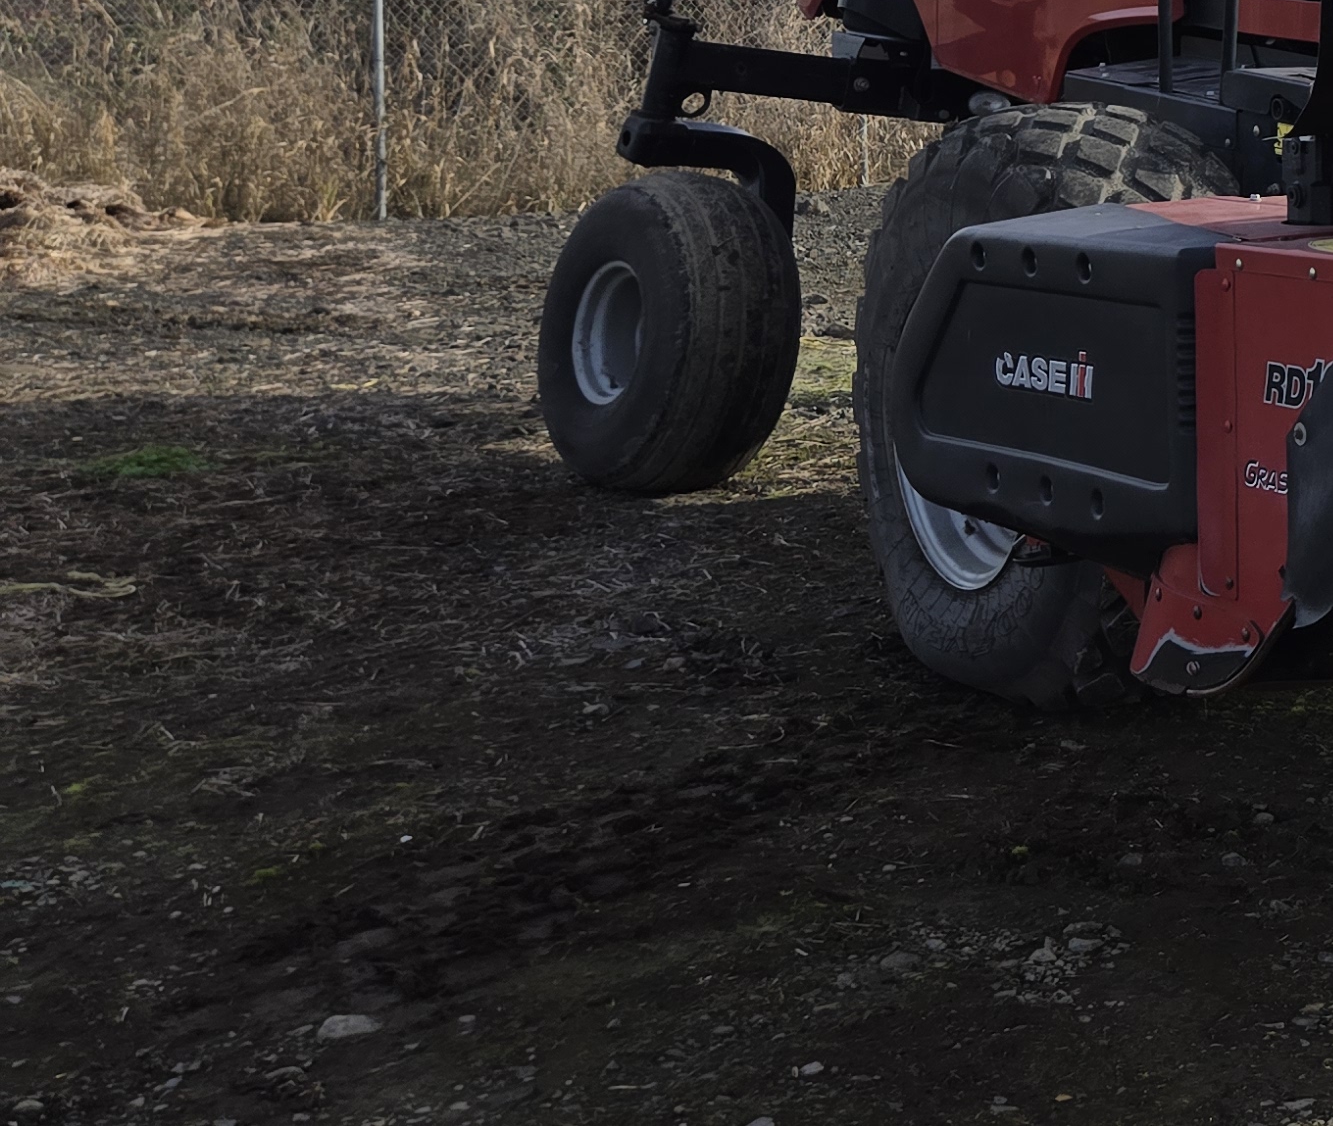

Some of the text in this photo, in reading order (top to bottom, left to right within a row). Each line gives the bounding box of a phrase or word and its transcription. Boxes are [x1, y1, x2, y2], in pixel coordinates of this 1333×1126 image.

[995, 351, 1067, 394] CASE
[1263, 359, 1333, 409] RD1
[1244, 460, 1289, 495] GRAS
[898, 566, 1046, 654] OODYEAR
